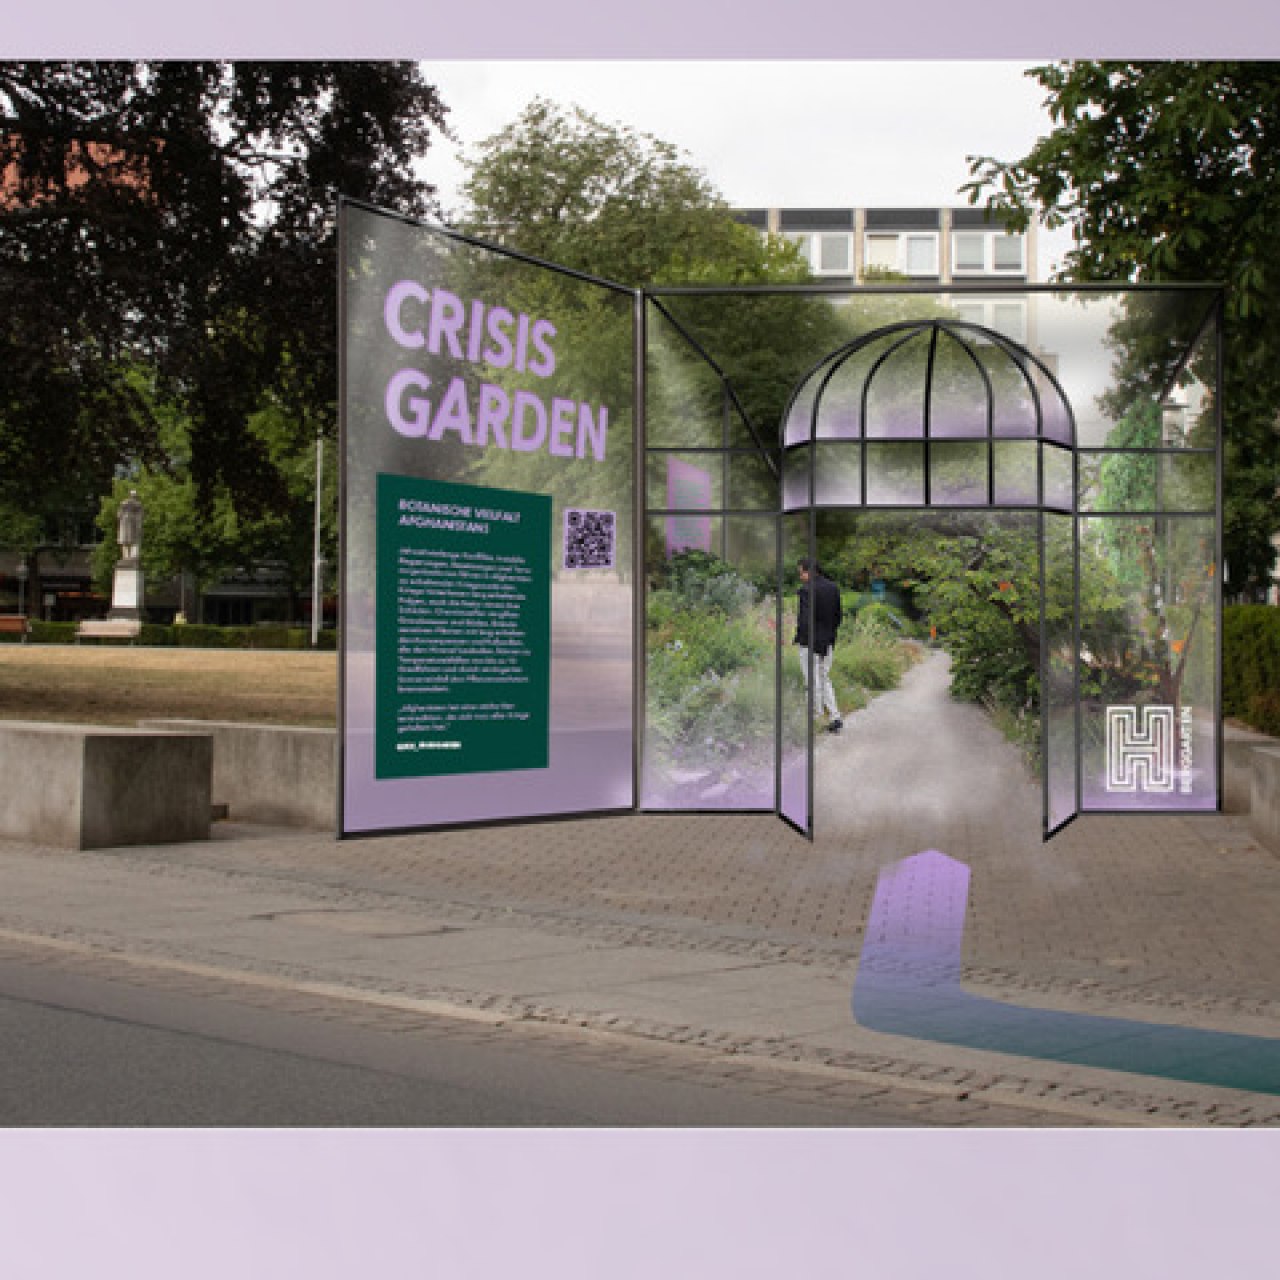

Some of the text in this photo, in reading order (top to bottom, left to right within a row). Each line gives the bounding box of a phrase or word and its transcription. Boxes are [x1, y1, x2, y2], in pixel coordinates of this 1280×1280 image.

[384, 279, 557, 378] CRISIS
[385, 367, 609, 462] GARDEN
[398, 498, 472, 518] BOTANISCHE
